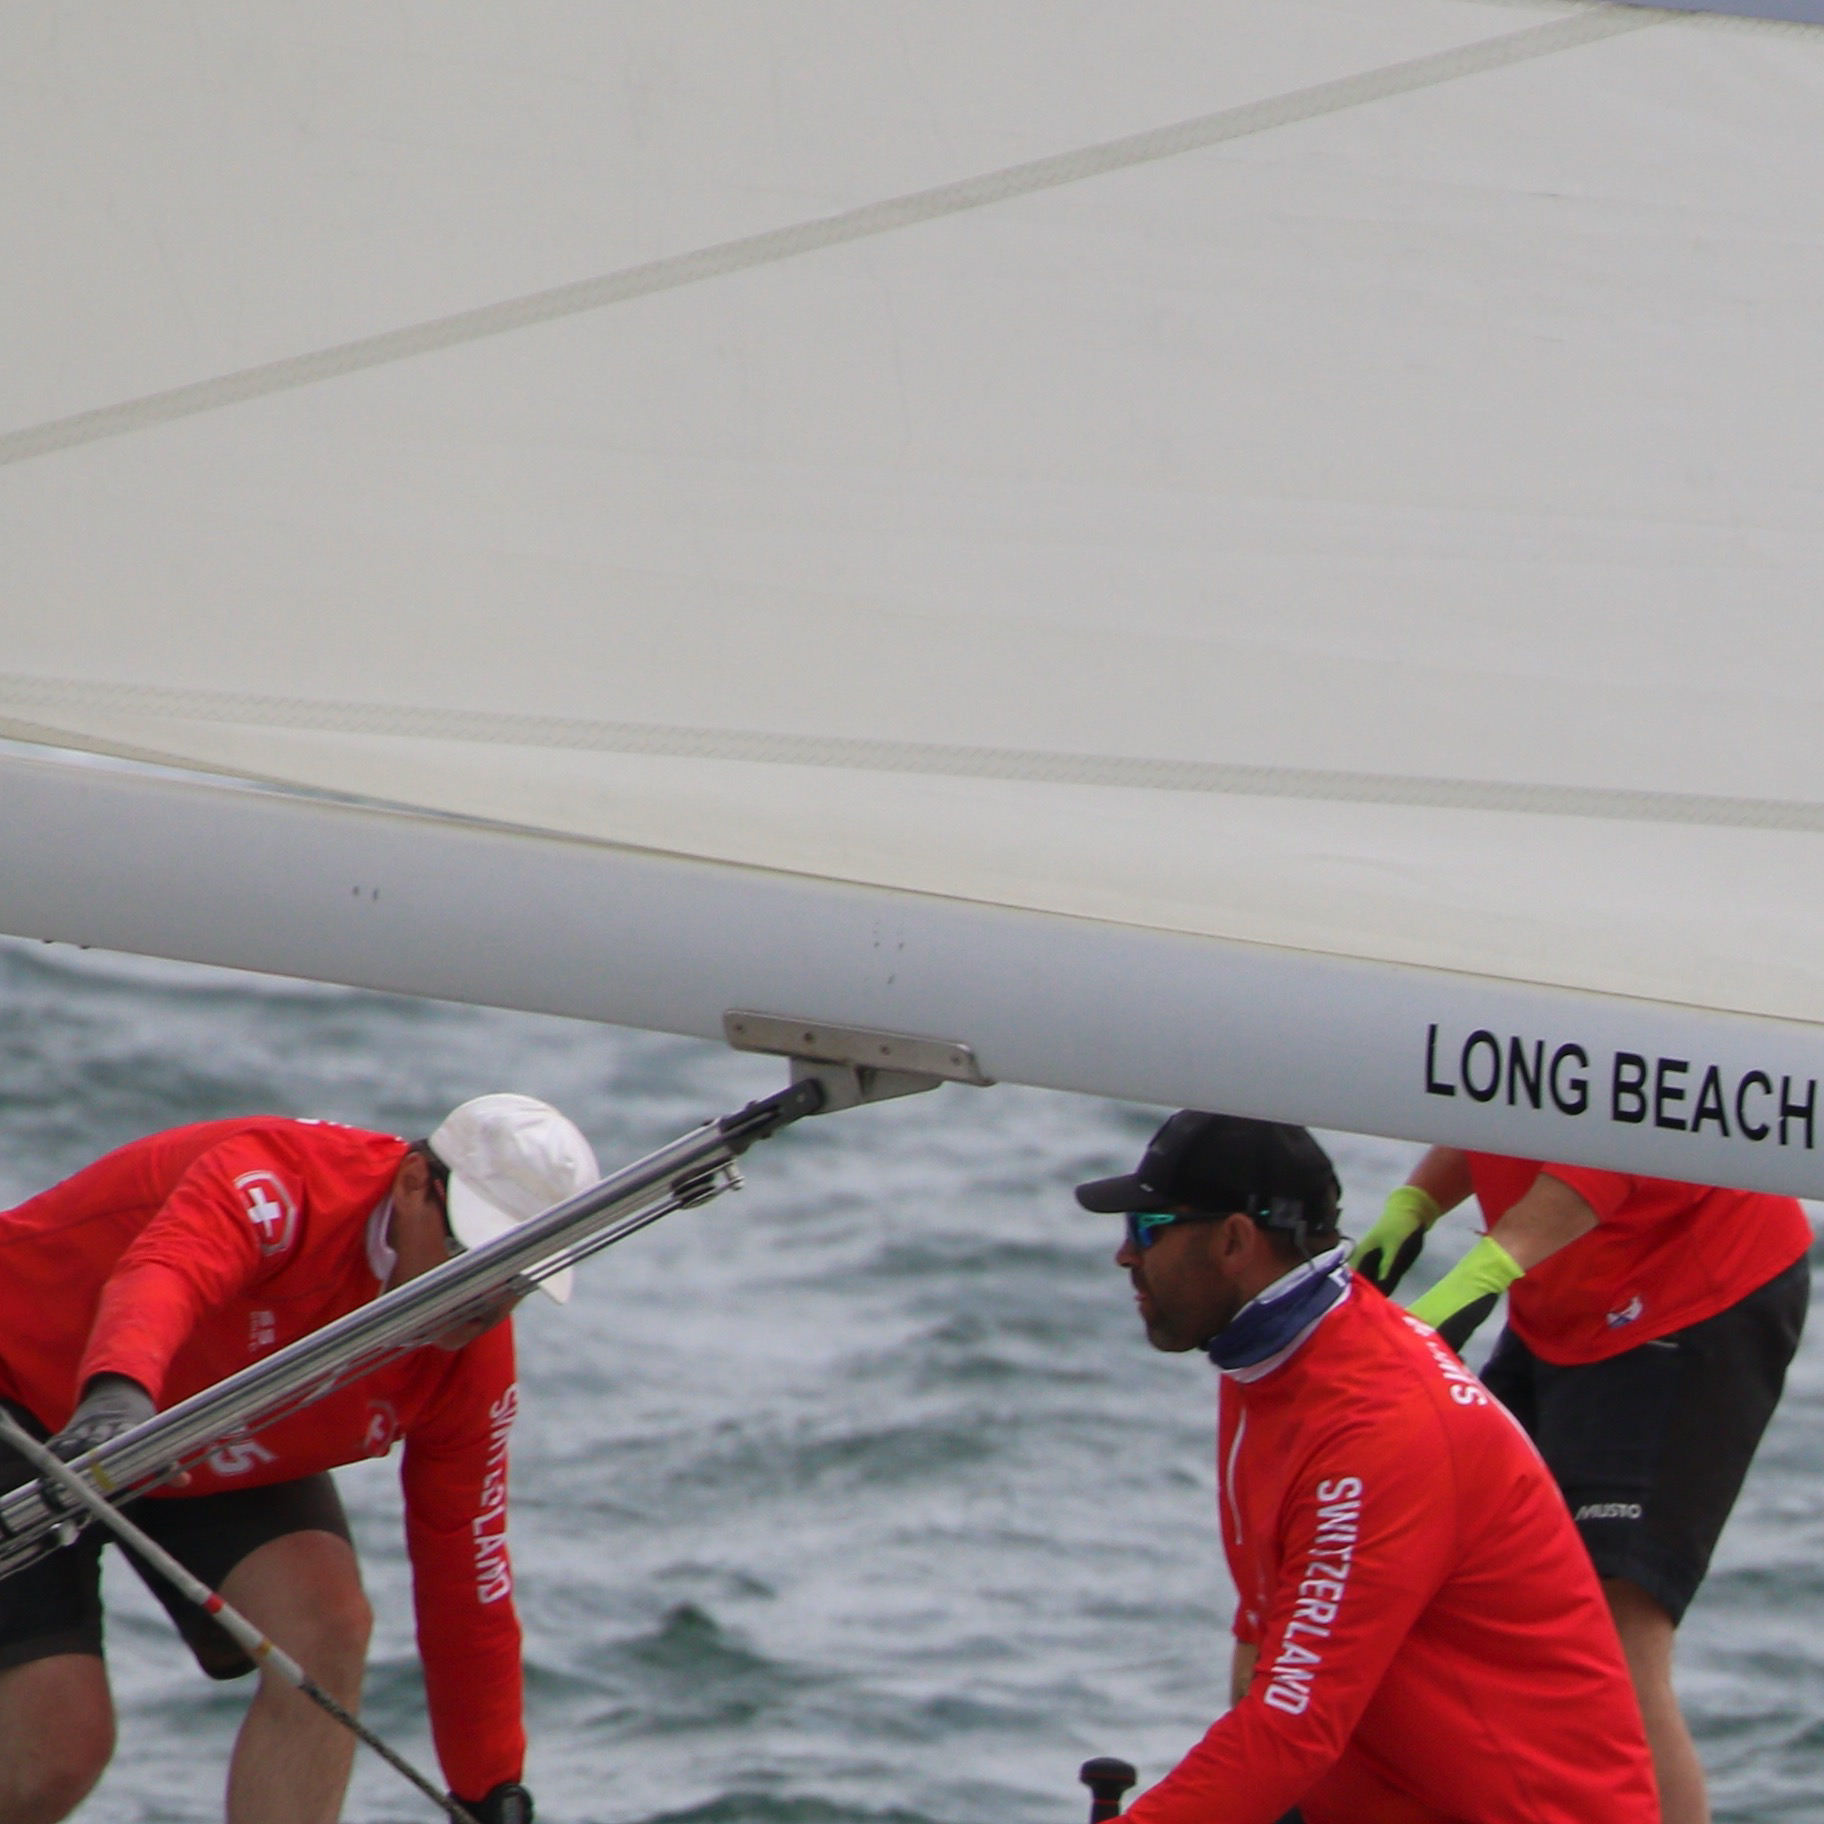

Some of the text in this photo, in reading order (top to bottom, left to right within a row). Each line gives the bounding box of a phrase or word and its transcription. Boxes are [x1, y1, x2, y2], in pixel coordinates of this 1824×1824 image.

[1425, 1023, 1589, 1116] LONG
[1610, 1052, 1815, 1150] BEACH
[1573, 1502, 1643, 1521] MUSTO
[1263, 1475, 1364, 1717] SWITZERLAND
